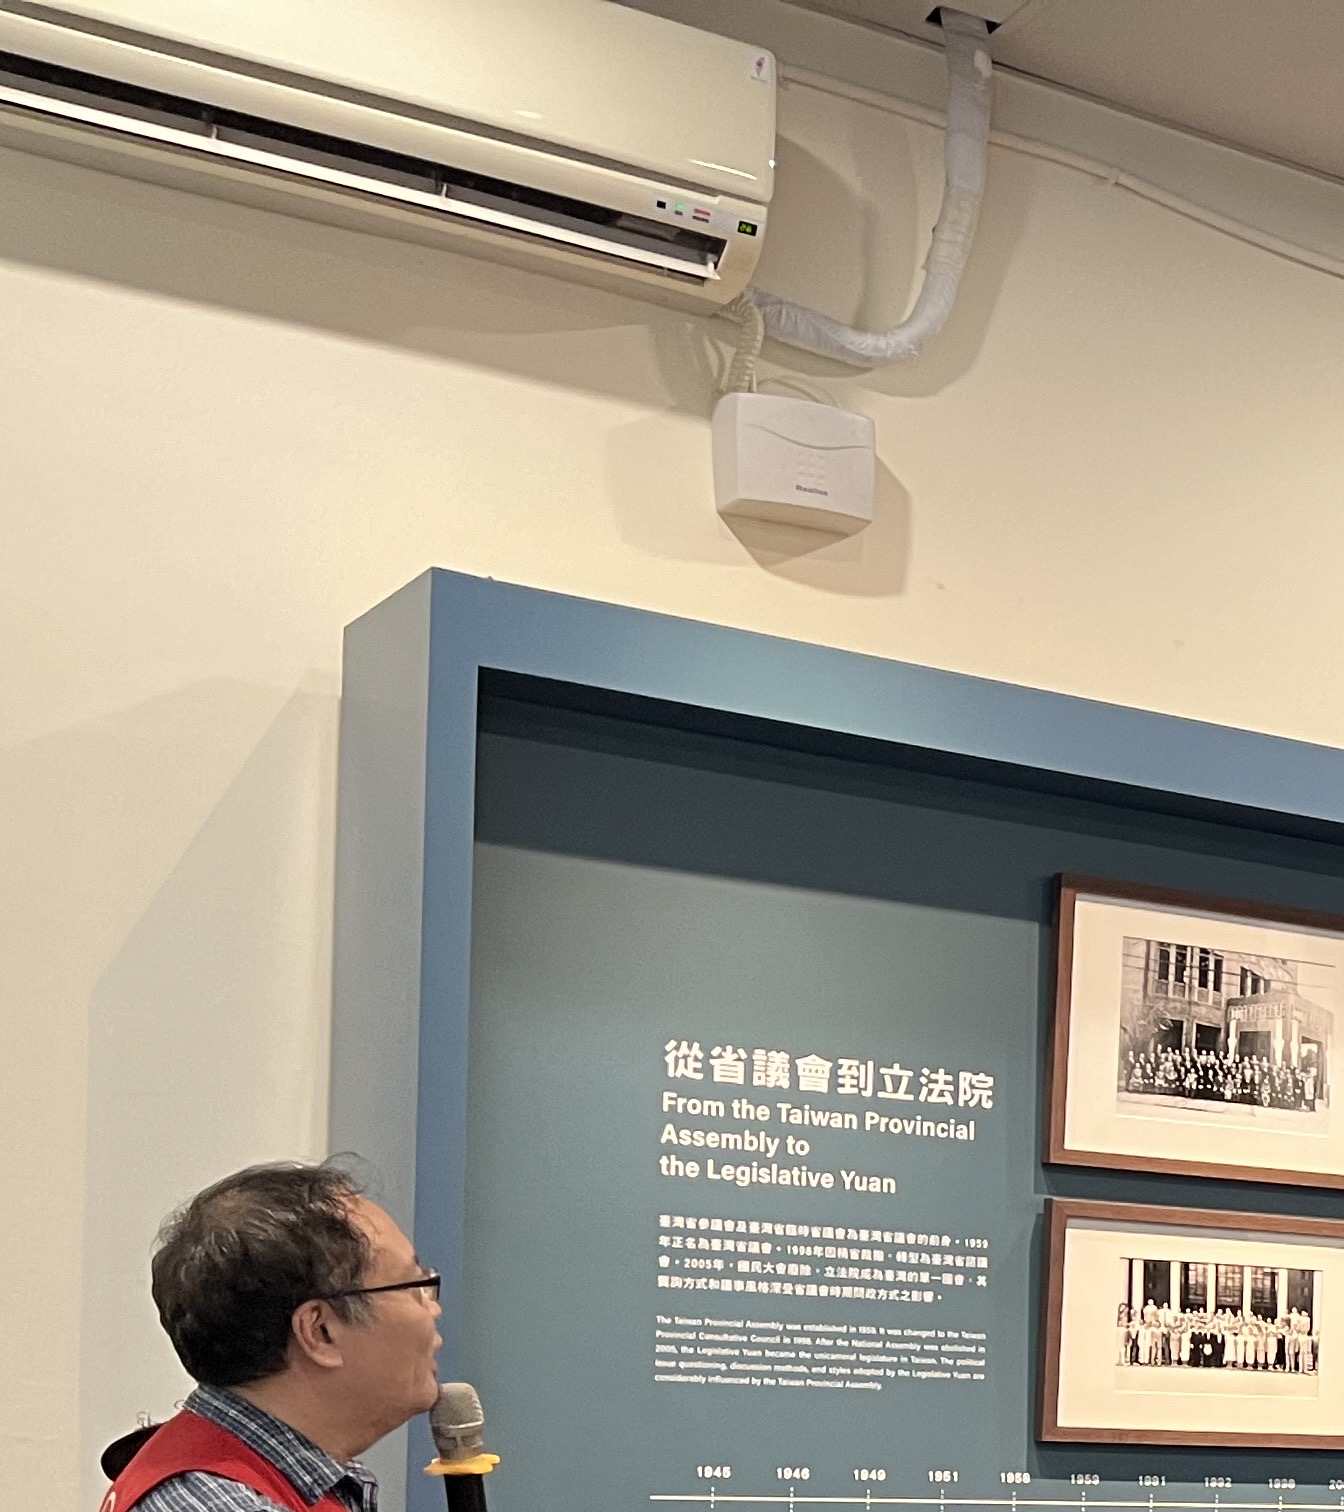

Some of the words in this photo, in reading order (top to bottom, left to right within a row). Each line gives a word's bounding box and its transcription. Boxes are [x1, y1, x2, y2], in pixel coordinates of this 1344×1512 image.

[664, 1039, 994, 1109] 從省議會到立法院
[662, 1091, 725, 1118] From
[731, 1098, 771, 1122] the
[776, 1102, 858, 1130] Taiwan
[865, 1111, 975, 1141] Provincial
[660, 1123, 780, 1158] Assembly
[785, 1135, 810, 1156] to
[659, 1154, 701, 1178] the
[707, 1158, 835, 1189] Legislative
[840, 1170, 896, 1194] Yuan
[697, 1466, 731, 1478] 1945
[776, 1467, 810, 1480] 1946
[853, 1468, 887, 1481] 1949
[928, 1470, 959, 1483] 1951
